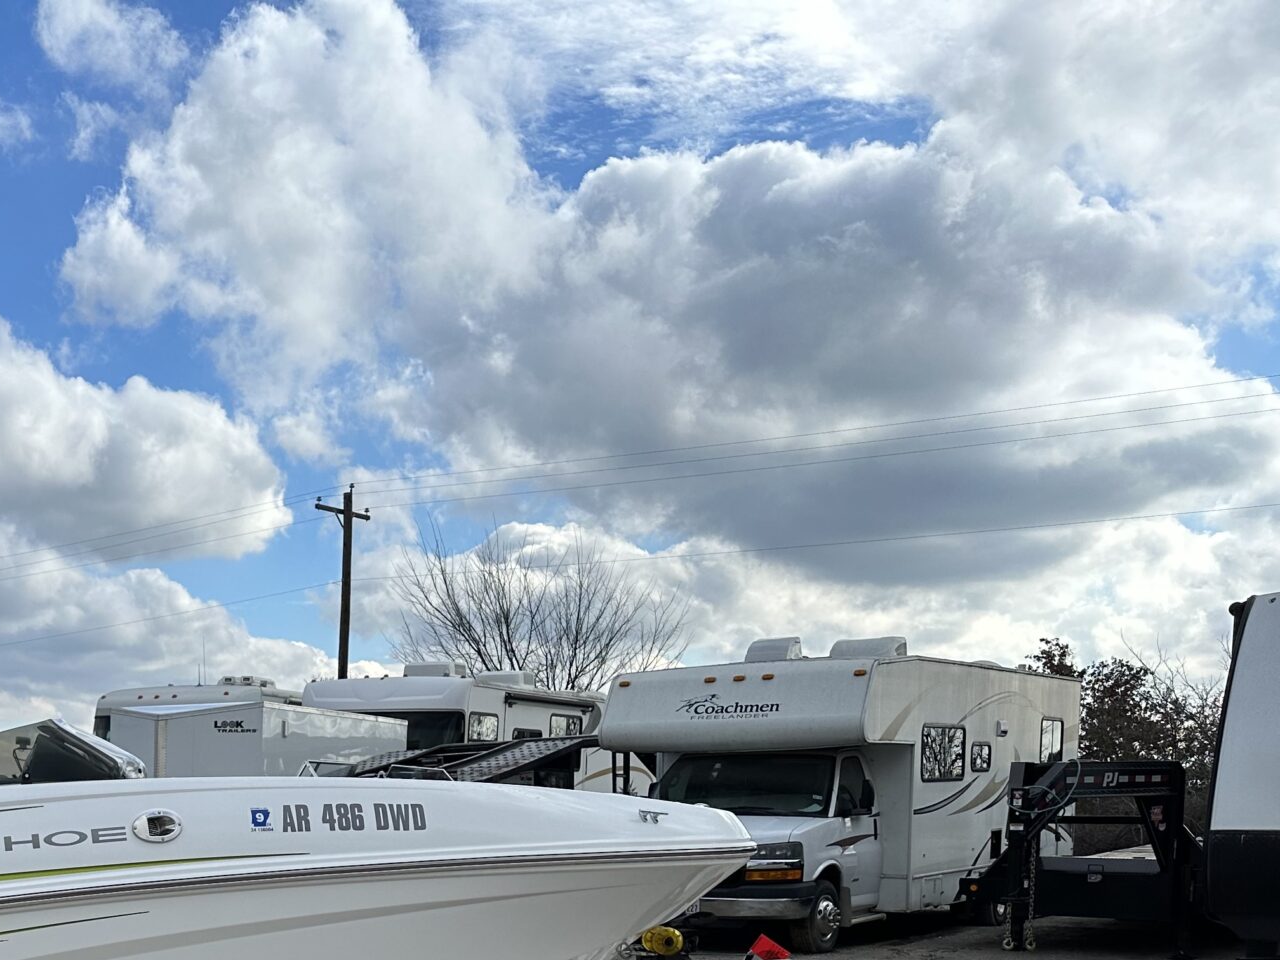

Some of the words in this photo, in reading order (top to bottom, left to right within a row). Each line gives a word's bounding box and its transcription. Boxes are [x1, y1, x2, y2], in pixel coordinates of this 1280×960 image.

[693, 702, 780, 715] Coachmen
[214, 720, 244, 729] LOOK
[1102, 772, 1119, 787] PJ
[255, 812, 265, 823] 9
[282, 804, 311, 833] AR
[322, 803, 365, 831] 486
[373, 803, 427, 831] DWD
